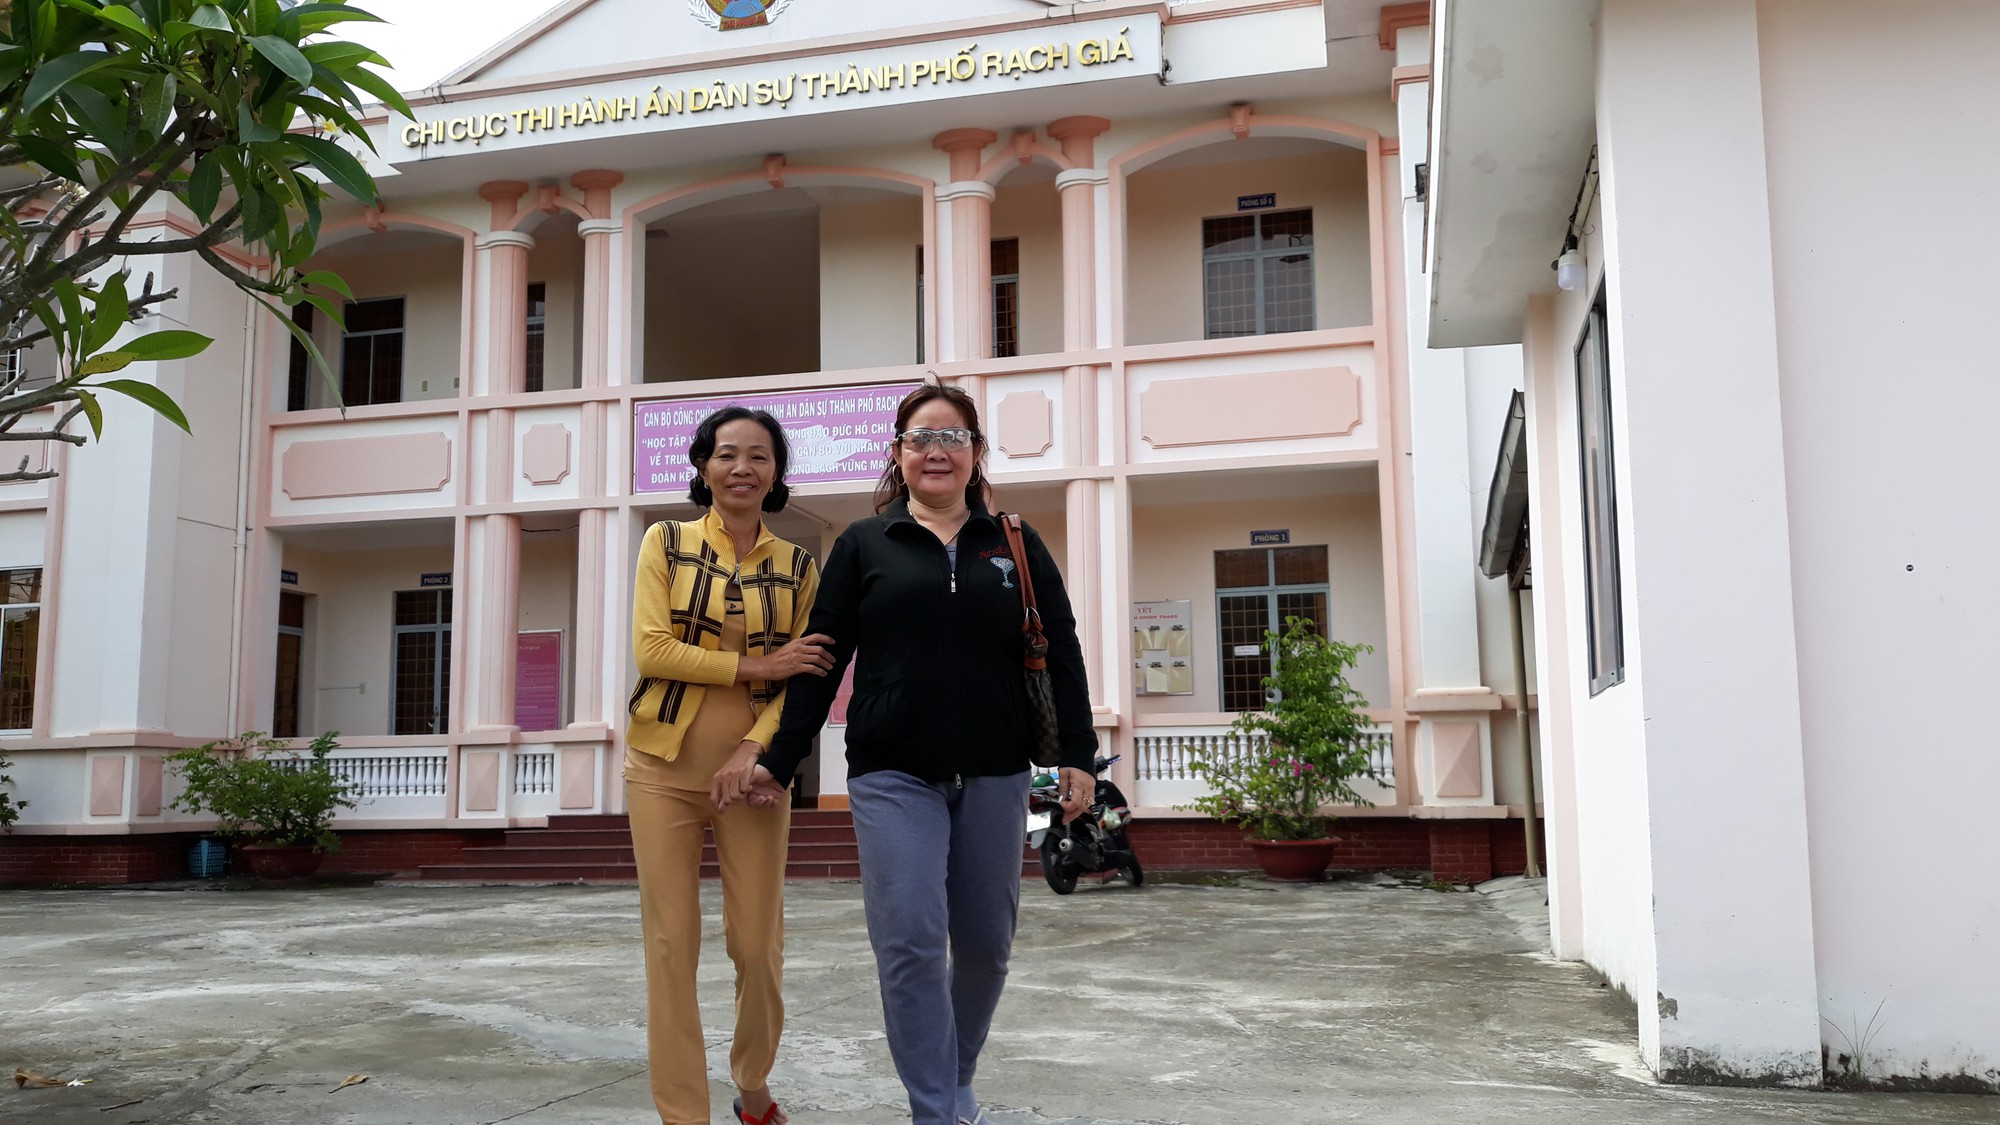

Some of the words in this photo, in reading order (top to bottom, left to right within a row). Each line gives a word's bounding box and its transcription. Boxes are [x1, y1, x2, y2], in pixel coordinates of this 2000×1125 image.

[401, 120, 444, 147] CHI
[447, 113, 506, 145] CỤC
[511, 107, 554, 134] THI
[559, 95, 637, 128] HÀNH
[643, 85, 683, 118] ÁN
[689, 79, 748, 114] DÂN
[753, 72, 797, 108] SỰ
[801, 62, 905, 98] THÀNH
[910, 43, 978, 87] PHỐ
[981, 42, 1069, 80] RẠCH
[1076, 26, 1134, 67] GIÁ
[786, 400, 797, 418] ÁN
[799, 398, 815, 417] DÂN
[817, 397, 828, 418] SỰ
[829, 395, 856, 415] THÀNH
[858, 391, 875, 413] PHỐ
[876, 395, 897, 414] RẠCH
[644, 409, 659, 427] CÁN
[661, 408, 672, 429] BỘ
[673, 406, 694, 426] CÔNG
[832, 423, 852, 437] ĐỨC
[871, 420, 887, 434] CHÍ
[668, 434, 687, 449] TẬP
[855, 438, 880, 453] NHÂN
[665, 454, 691, 465] TRUN
[651, 470, 676, 484] ĐOÀN
[1254, 534, 1279, 542] PHÒNG
[1281, 533, 1286, 541] 1
